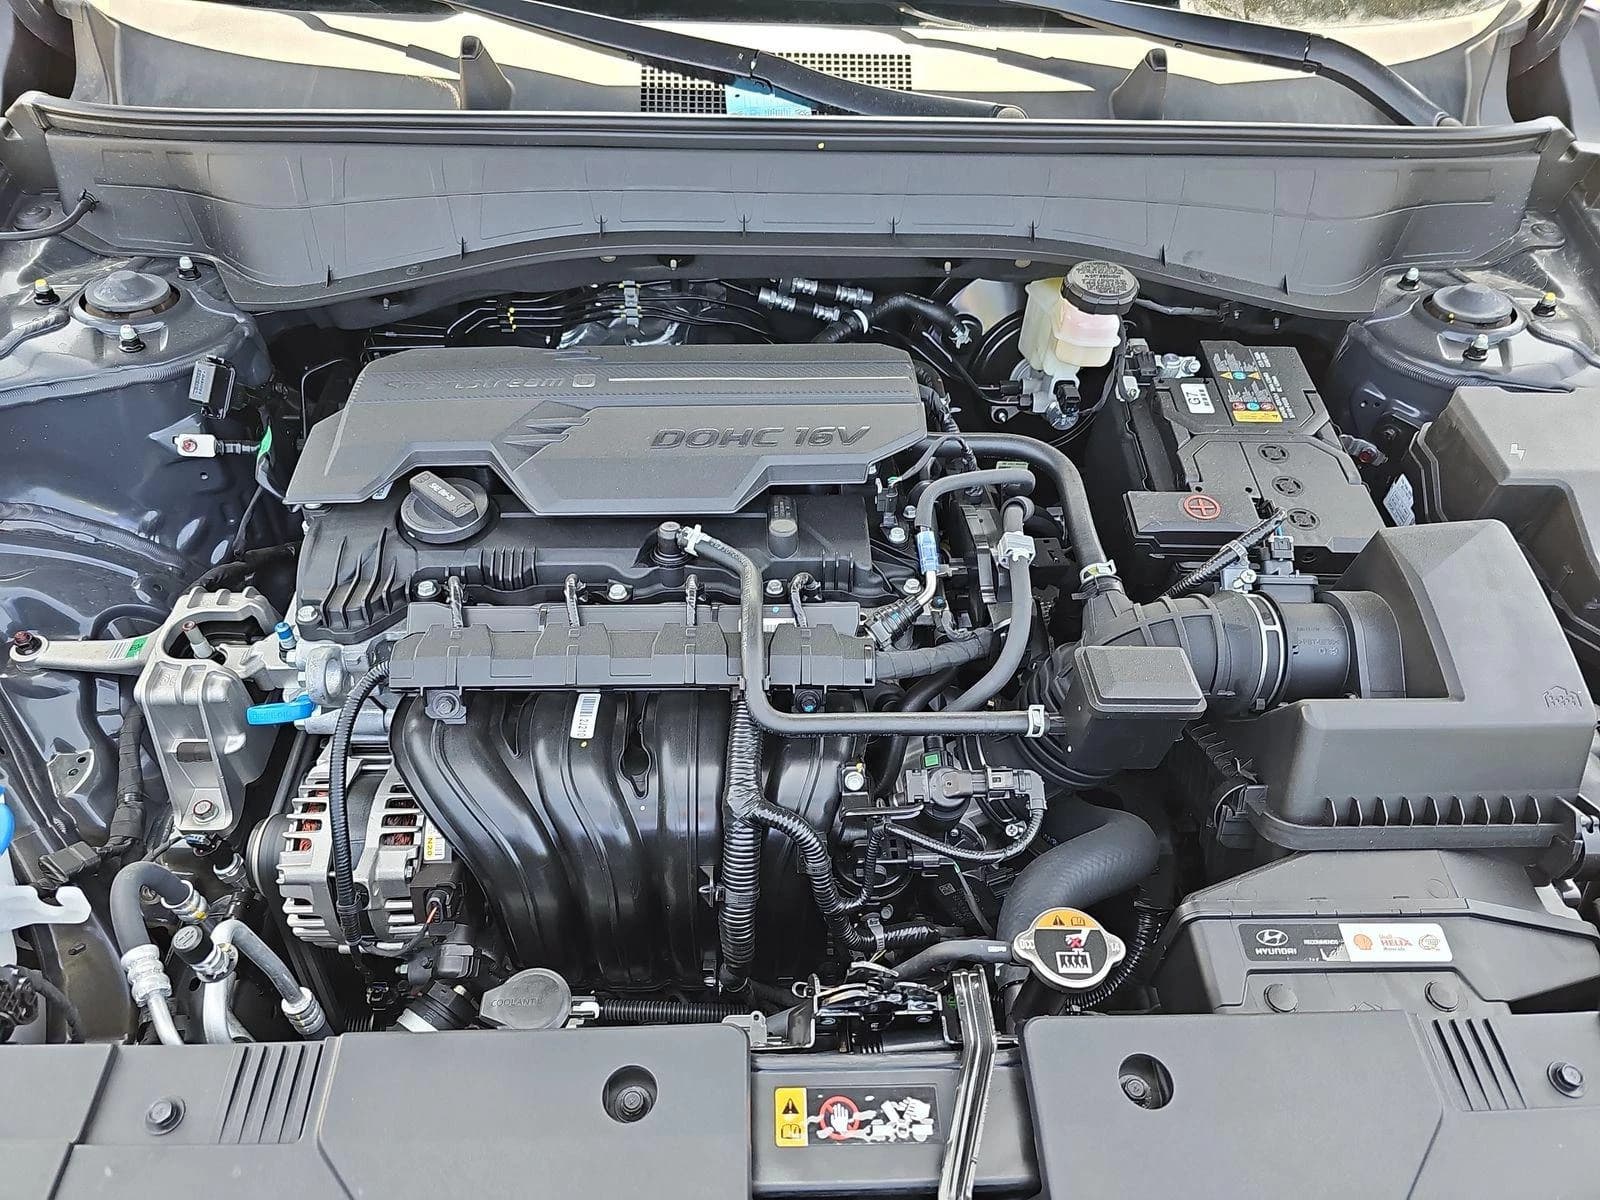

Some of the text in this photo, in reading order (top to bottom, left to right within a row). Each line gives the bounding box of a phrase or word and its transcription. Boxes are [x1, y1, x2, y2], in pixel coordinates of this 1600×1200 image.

[650, 425, 871, 450] DOHC 16V
[1255, 947, 1298, 956] HYUNDAI
[491, 998, 537, 1008] COOLANT
